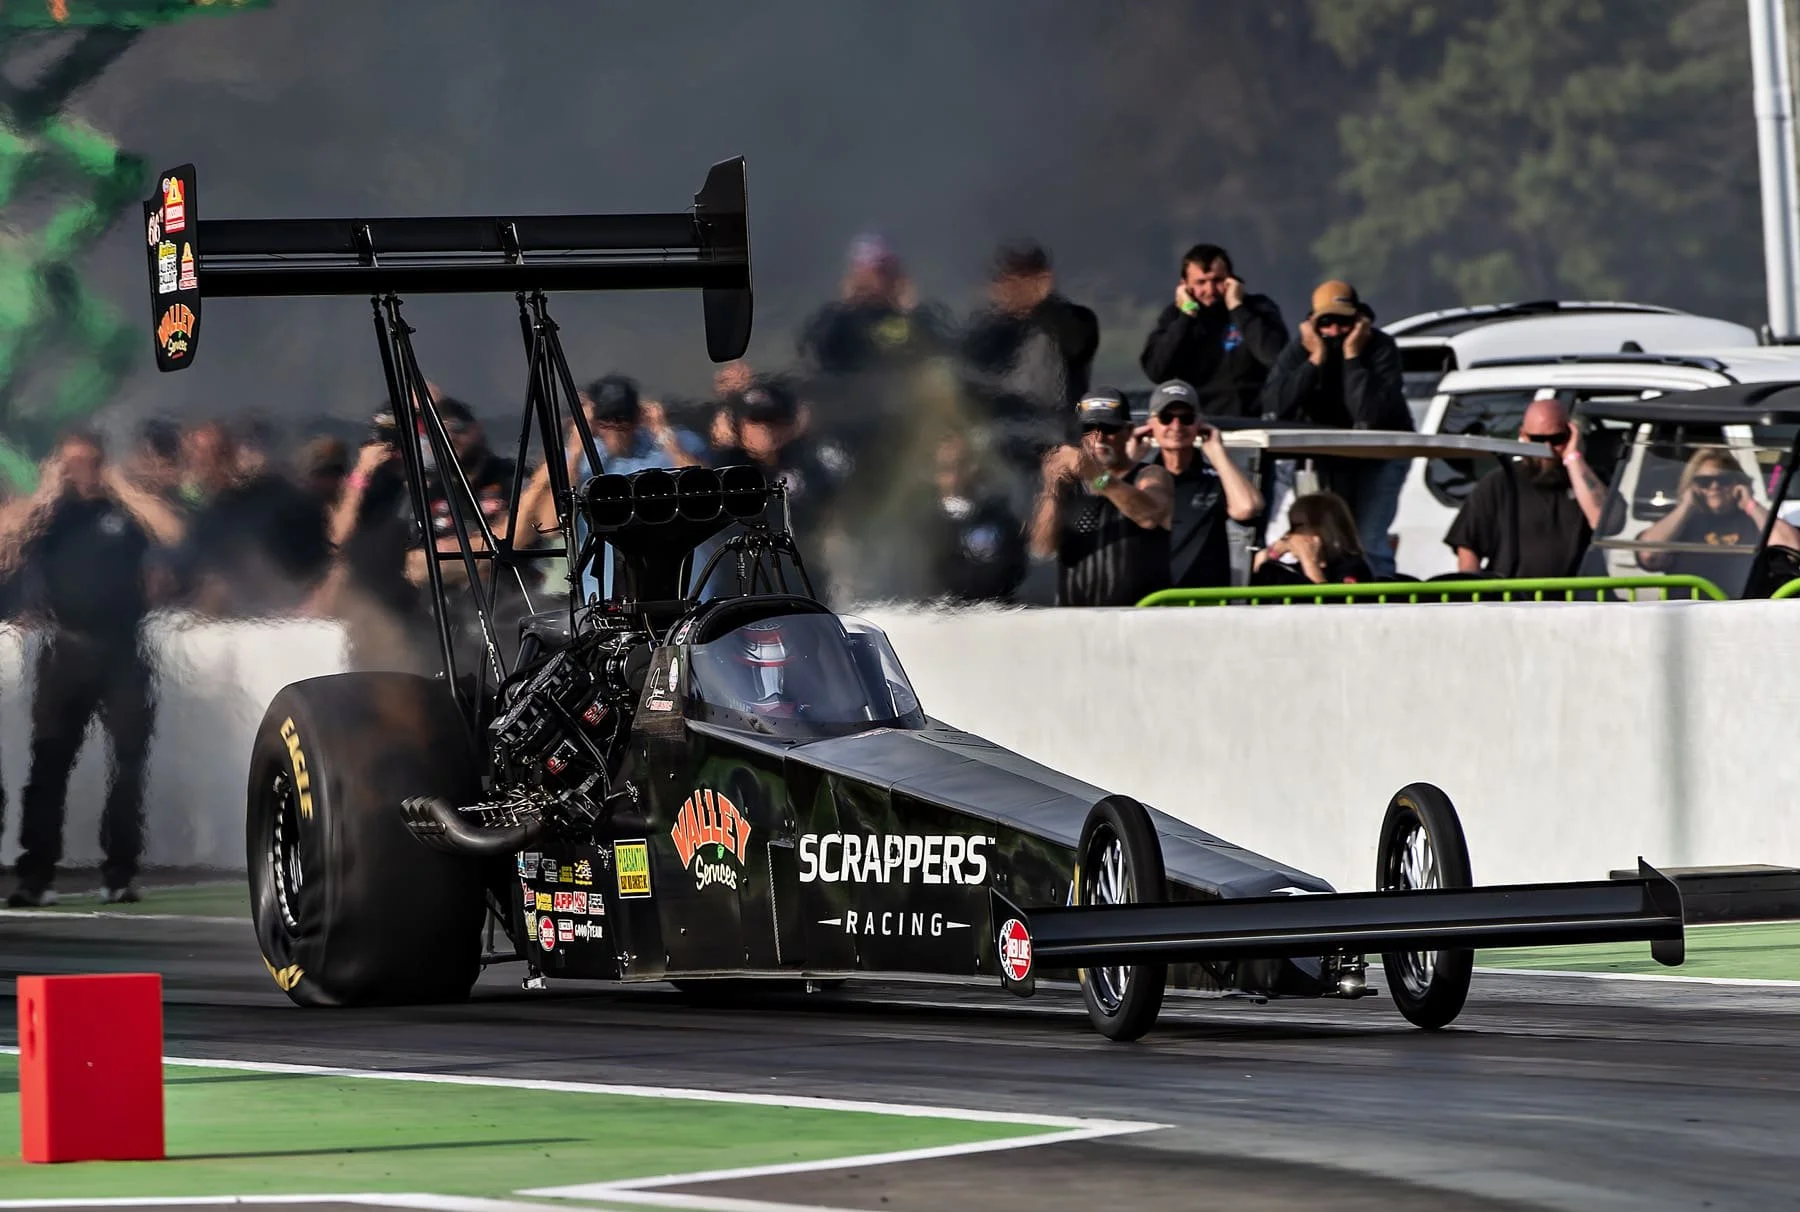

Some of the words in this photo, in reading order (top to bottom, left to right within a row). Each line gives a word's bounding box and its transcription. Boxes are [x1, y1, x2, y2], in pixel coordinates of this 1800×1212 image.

[158, 303, 196, 348] VALLEY
[280, 715, 314, 820] EAGLE
[671, 788, 752, 870] VALLEY
[695, 854, 737, 890] Services
[799, 833, 988, 885] SCRAPPERS
[845, 910, 943, 936] RACING
